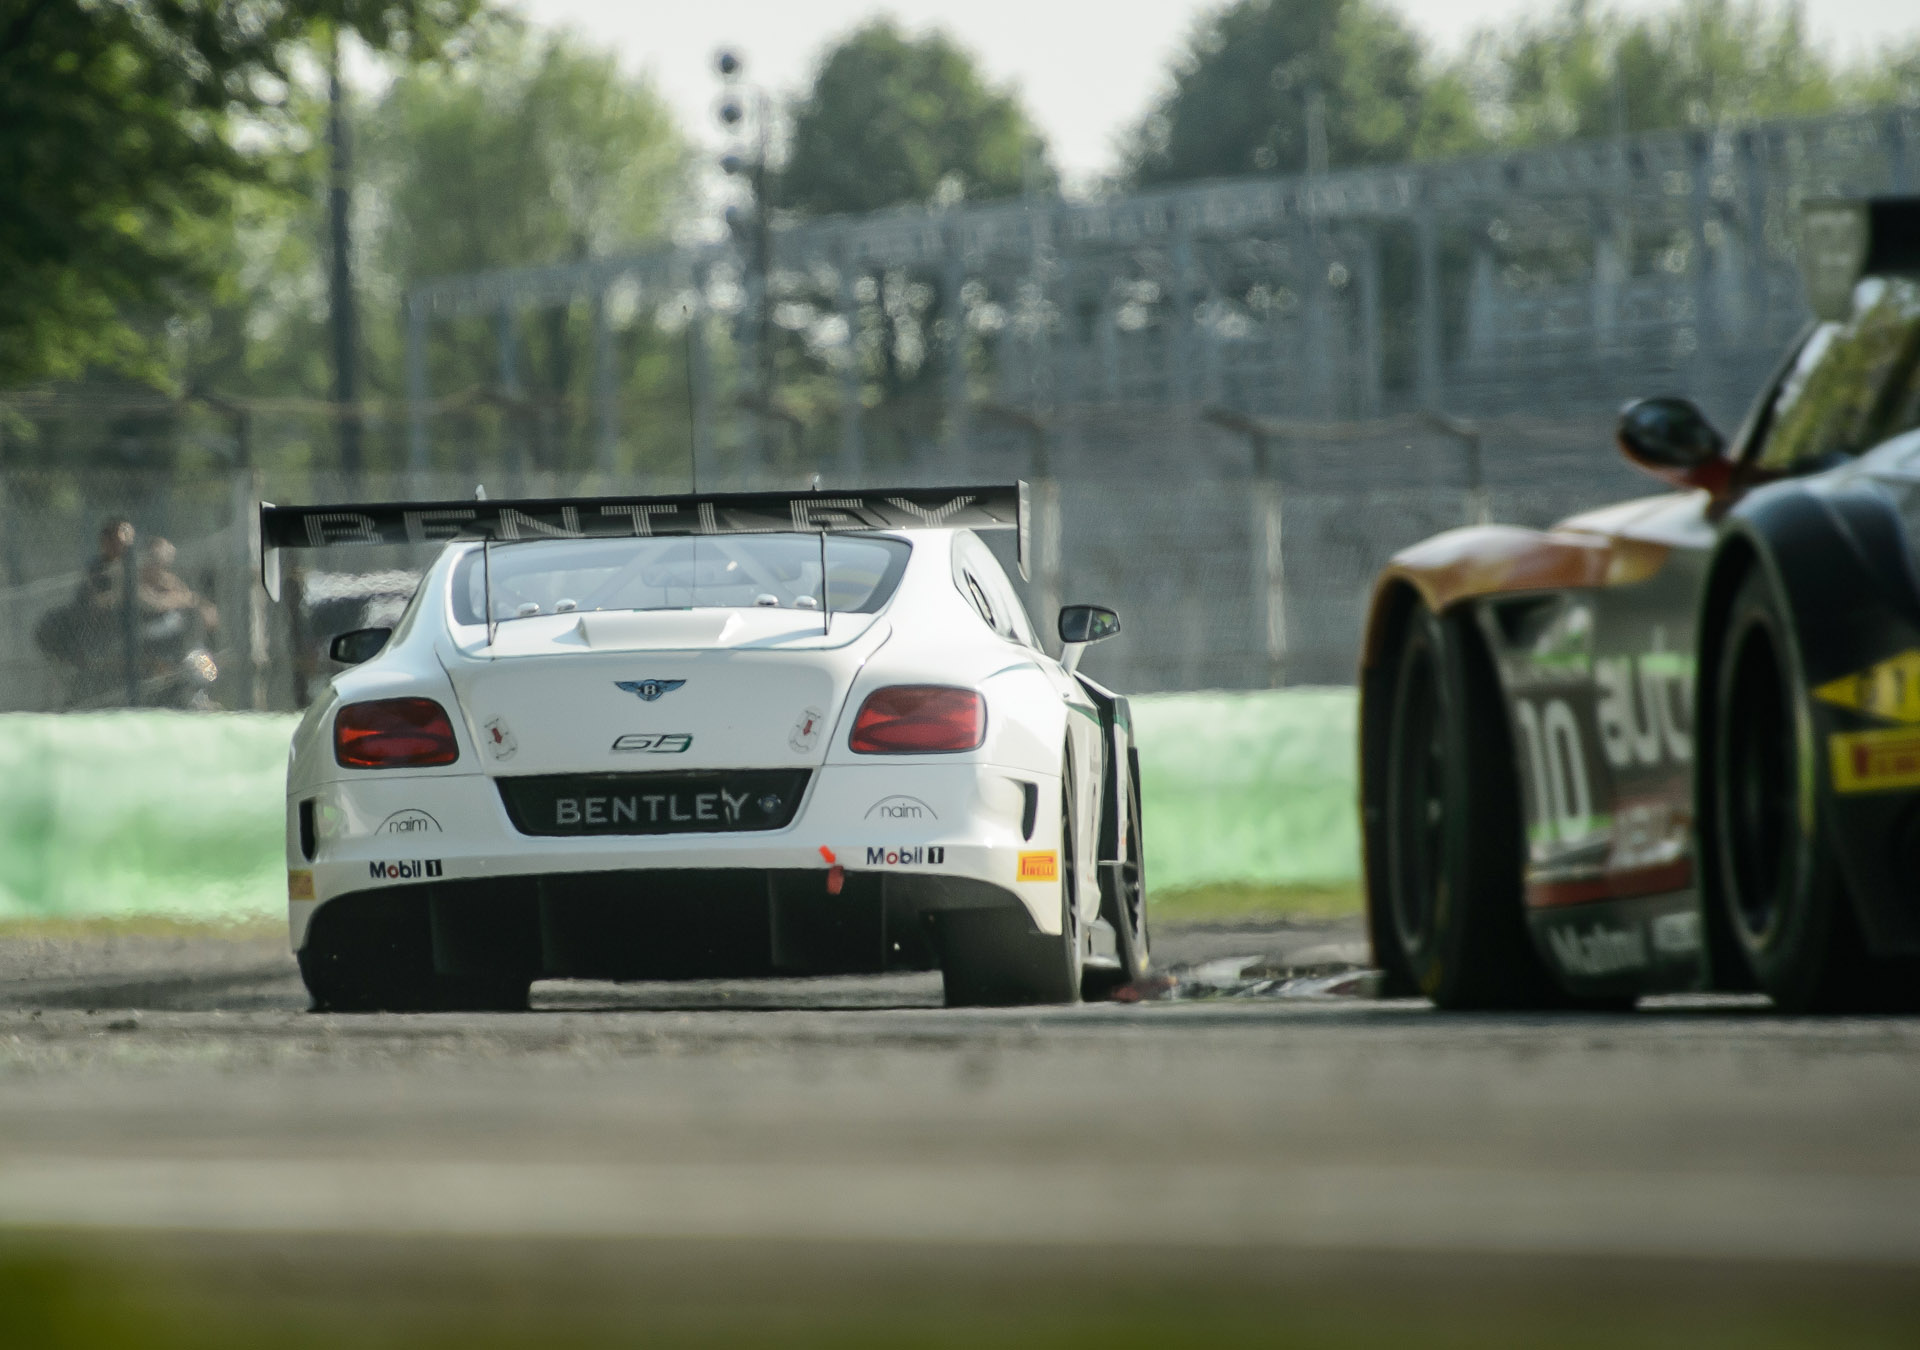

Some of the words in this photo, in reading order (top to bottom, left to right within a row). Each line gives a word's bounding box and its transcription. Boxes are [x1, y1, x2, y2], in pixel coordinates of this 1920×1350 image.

[303, 495, 977, 546] BENTLEY
[556, 792, 750, 825] BENTLEY
[881, 803, 922, 818] naim
[389, 816, 428, 832] naim
[866, 846, 923, 865] Mobil
[369, 860, 422, 879] Mobil
